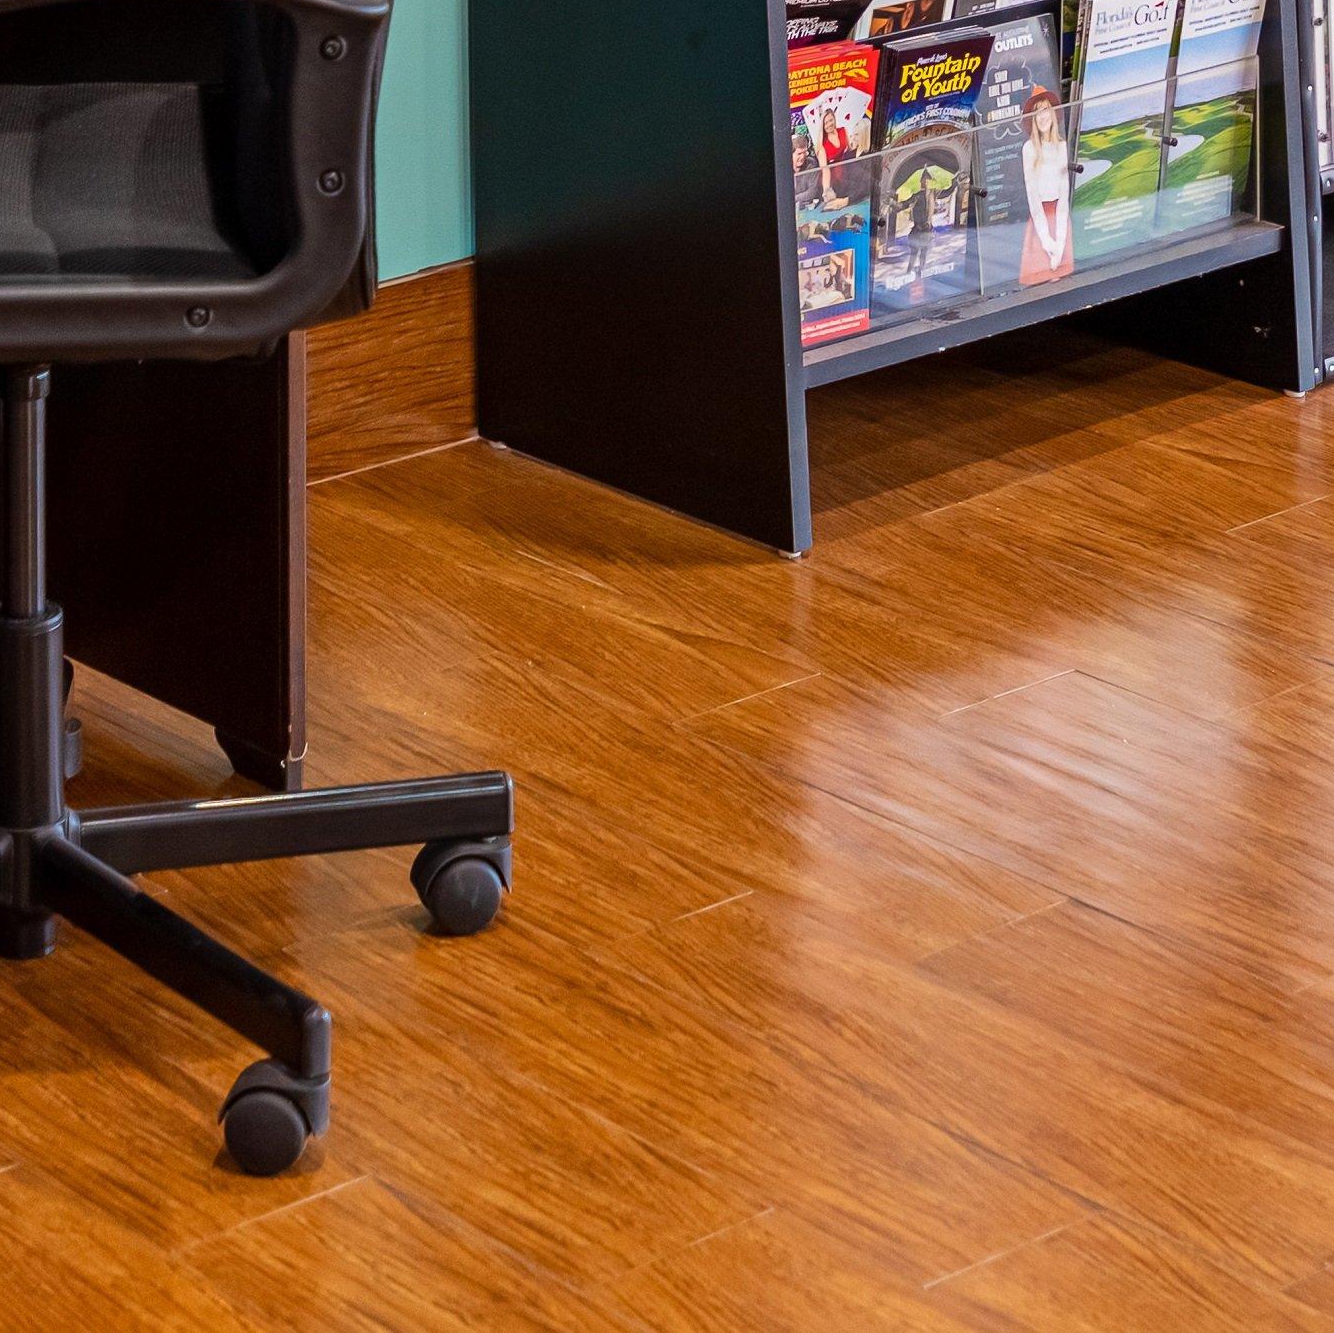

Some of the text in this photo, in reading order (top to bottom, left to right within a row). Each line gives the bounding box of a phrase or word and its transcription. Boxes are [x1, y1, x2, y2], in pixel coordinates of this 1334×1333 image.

[993, 33, 1034, 53] OUTLETS
[832, 57, 868, 72] BEACH
[899, 52, 982, 89] Fountain
[789, 77, 847, 97] POKER ROOM
[900, 83, 920, 104] of
[917, 72, 973, 101] Youth
